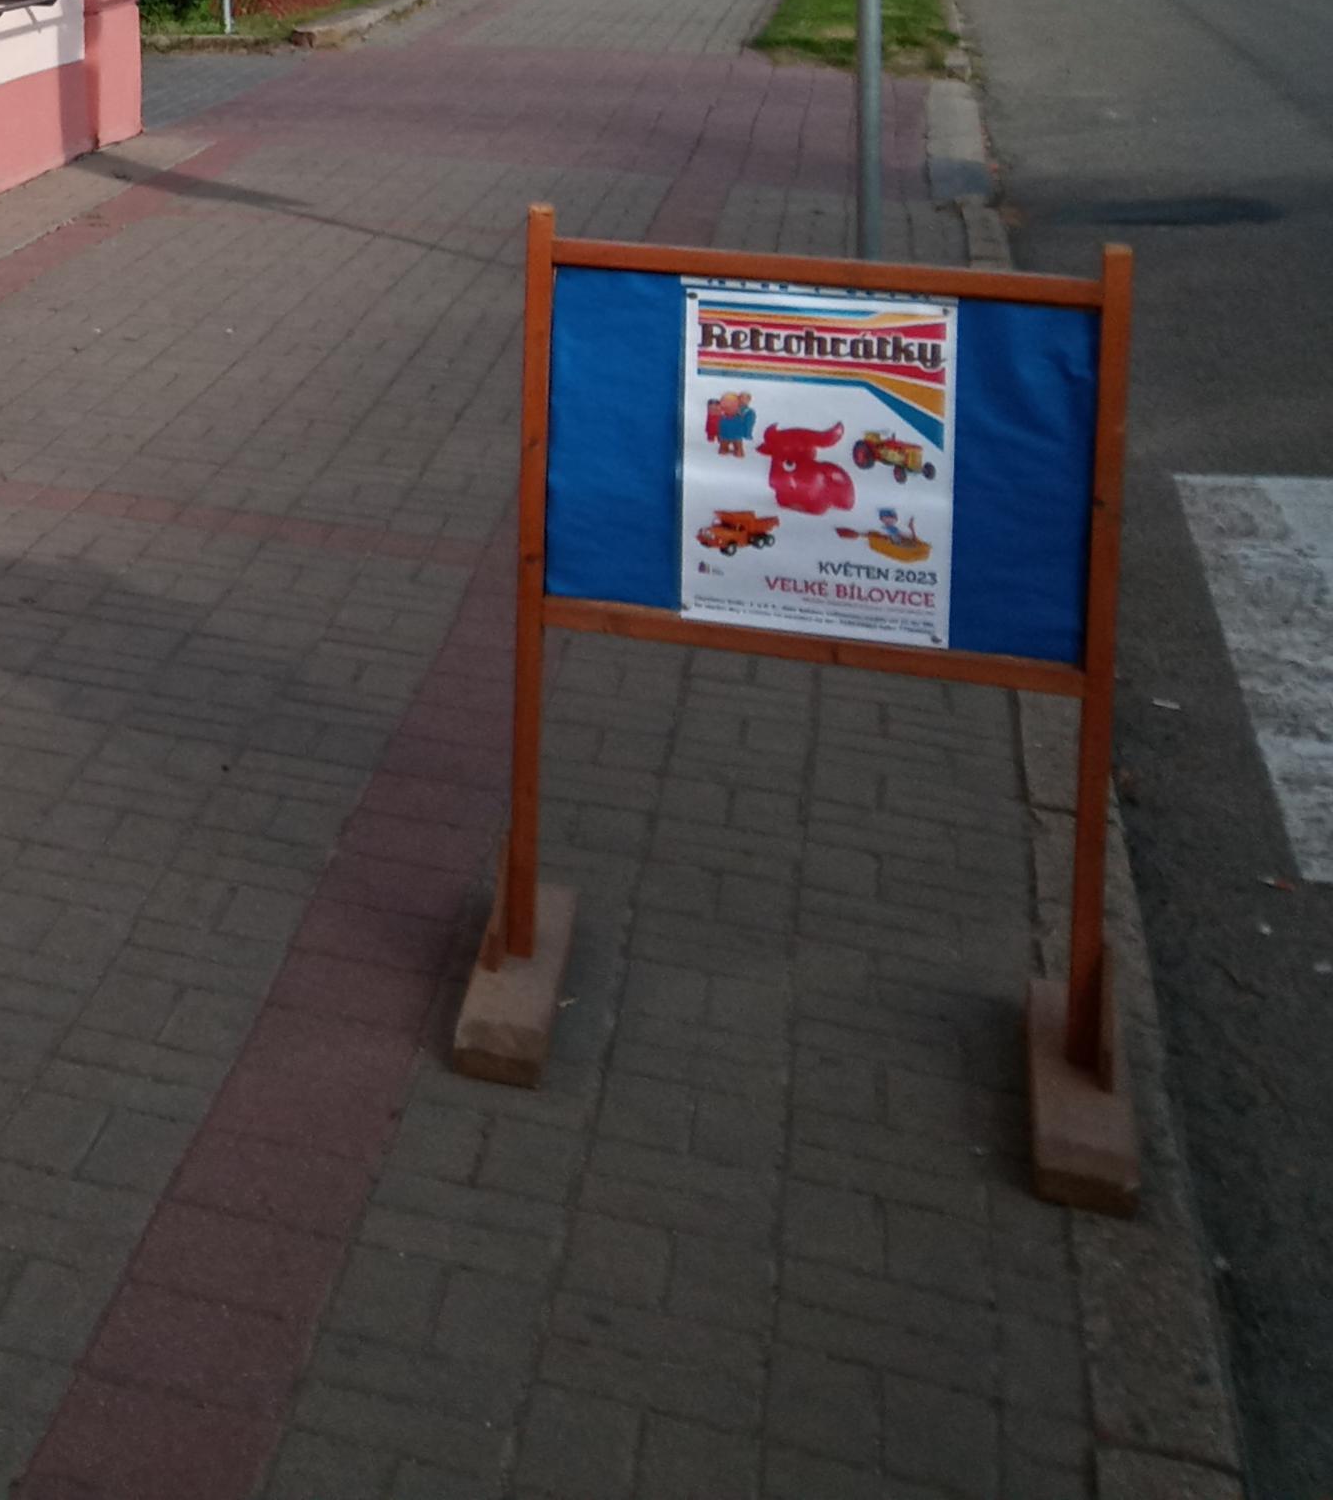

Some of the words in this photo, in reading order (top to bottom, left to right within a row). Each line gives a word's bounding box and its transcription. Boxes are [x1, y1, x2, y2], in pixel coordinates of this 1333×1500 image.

[697, 322, 947, 370] Retrohrátky
[818, 561, 890, 581] KVĚTEN
[894, 569, 938, 586] 2023
[765, 575, 829, 598] VELKÉ
[835, 582, 936, 609] BÍLOVICE
